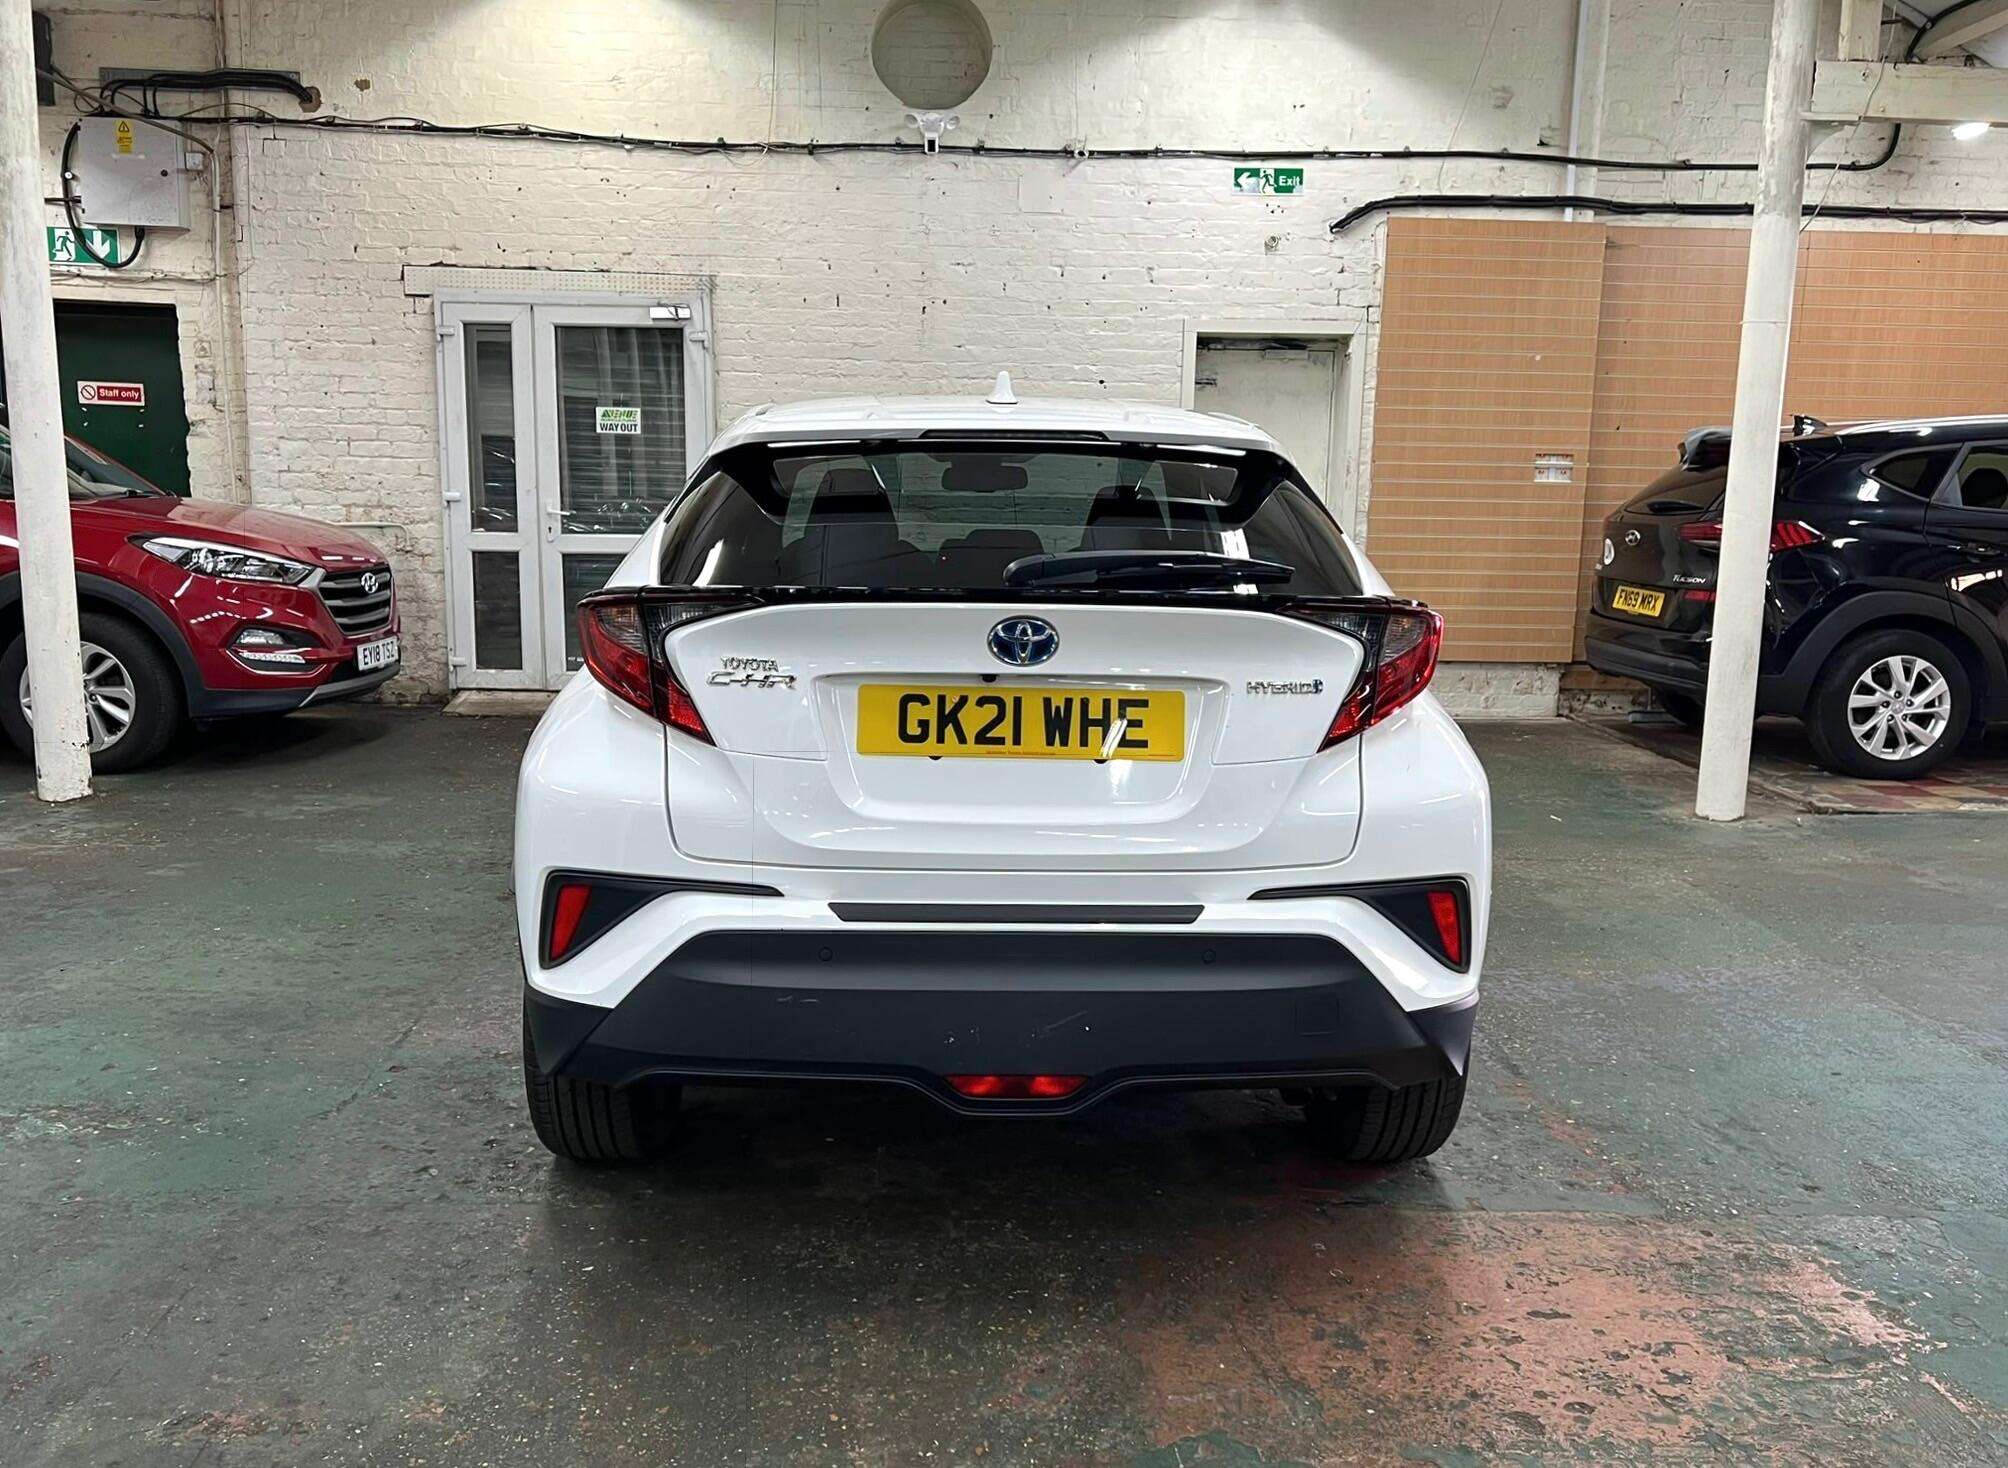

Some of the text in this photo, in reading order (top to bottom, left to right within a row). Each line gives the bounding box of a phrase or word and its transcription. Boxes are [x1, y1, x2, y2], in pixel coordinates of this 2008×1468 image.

[1279, 175, 1301, 186] Exit
[99, 388, 139, 400] Staff only
[599, 422, 638, 432] WAY OUT
[1638, 594, 1660, 613] MRX
[362, 640, 395, 666] EY18 TSZ
[720, 657, 779, 672] TOYOTA
[897, 692, 1150, 749] GK21 WHE
